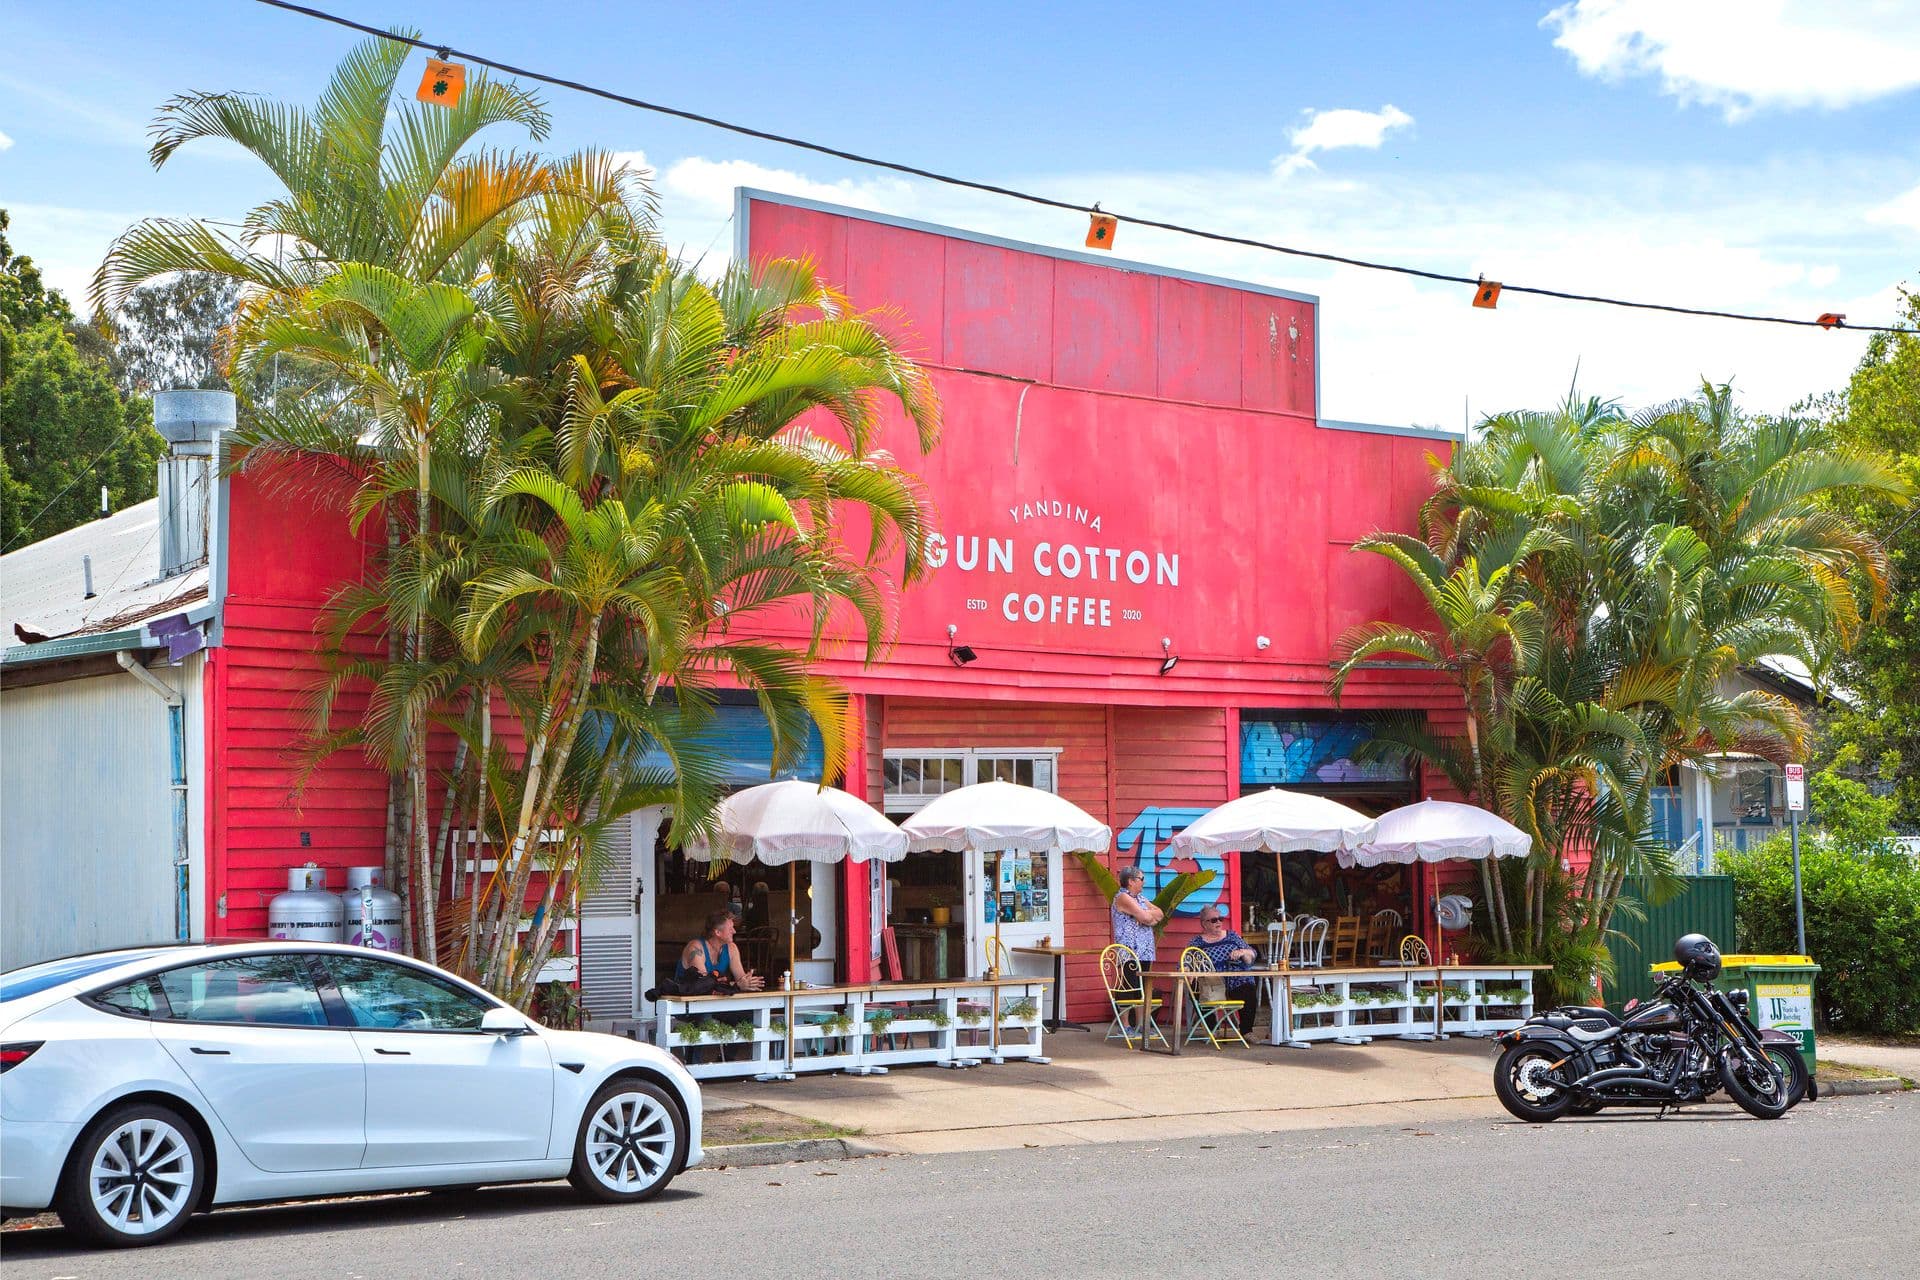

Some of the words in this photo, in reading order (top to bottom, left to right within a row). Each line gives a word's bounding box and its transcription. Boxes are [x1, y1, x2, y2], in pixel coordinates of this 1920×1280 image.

[1010, 500, 1101, 533] YANDINA
[923, 532, 1013, 573] GUN
[1033, 542, 1179, 586] COTTON
[967, 598, 987, 610] ESTD
[1002, 592, 1111, 627] COFFEE
[1122, 609, 1142, 621] 2020
